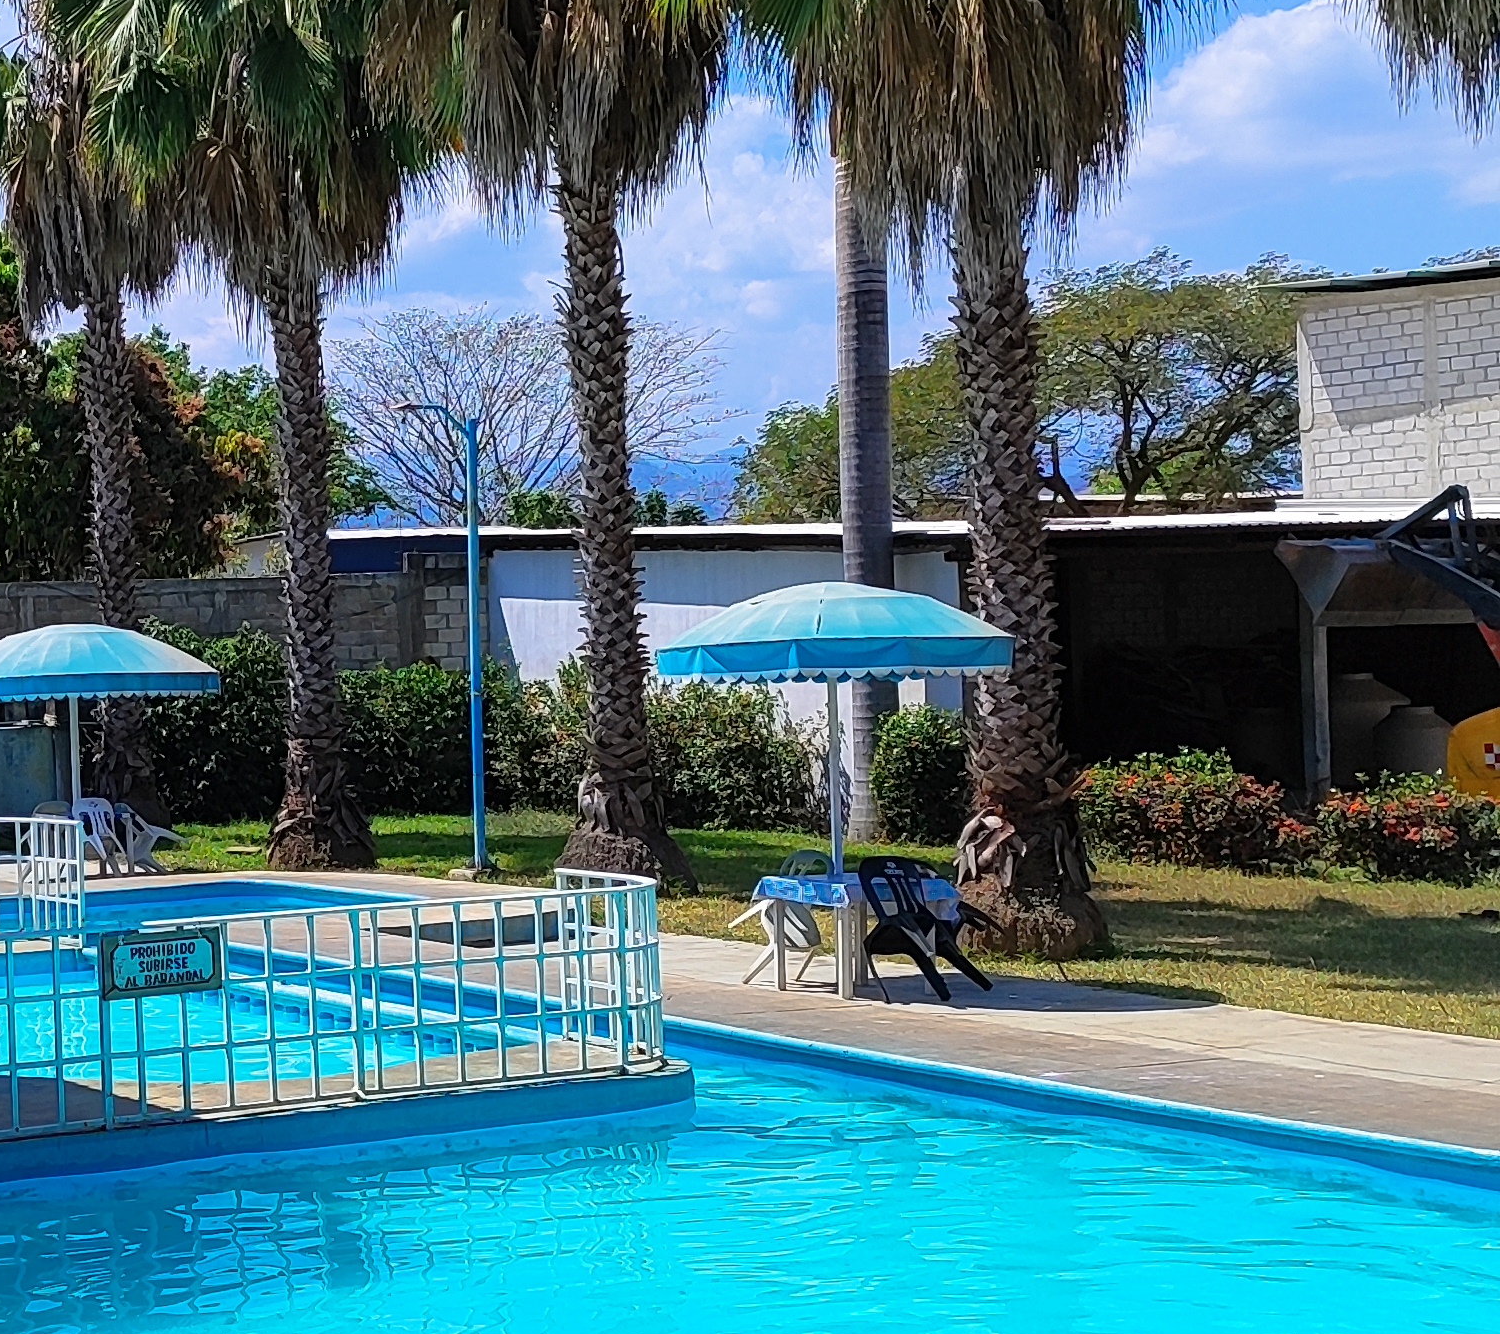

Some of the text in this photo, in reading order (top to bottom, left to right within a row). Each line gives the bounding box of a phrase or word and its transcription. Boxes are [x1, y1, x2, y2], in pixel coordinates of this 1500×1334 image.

[129, 941, 197, 961] PROHIBIDO
[138, 956, 190, 974] SUBIRSE
[124, 968, 206, 988] AL BARANDAL
